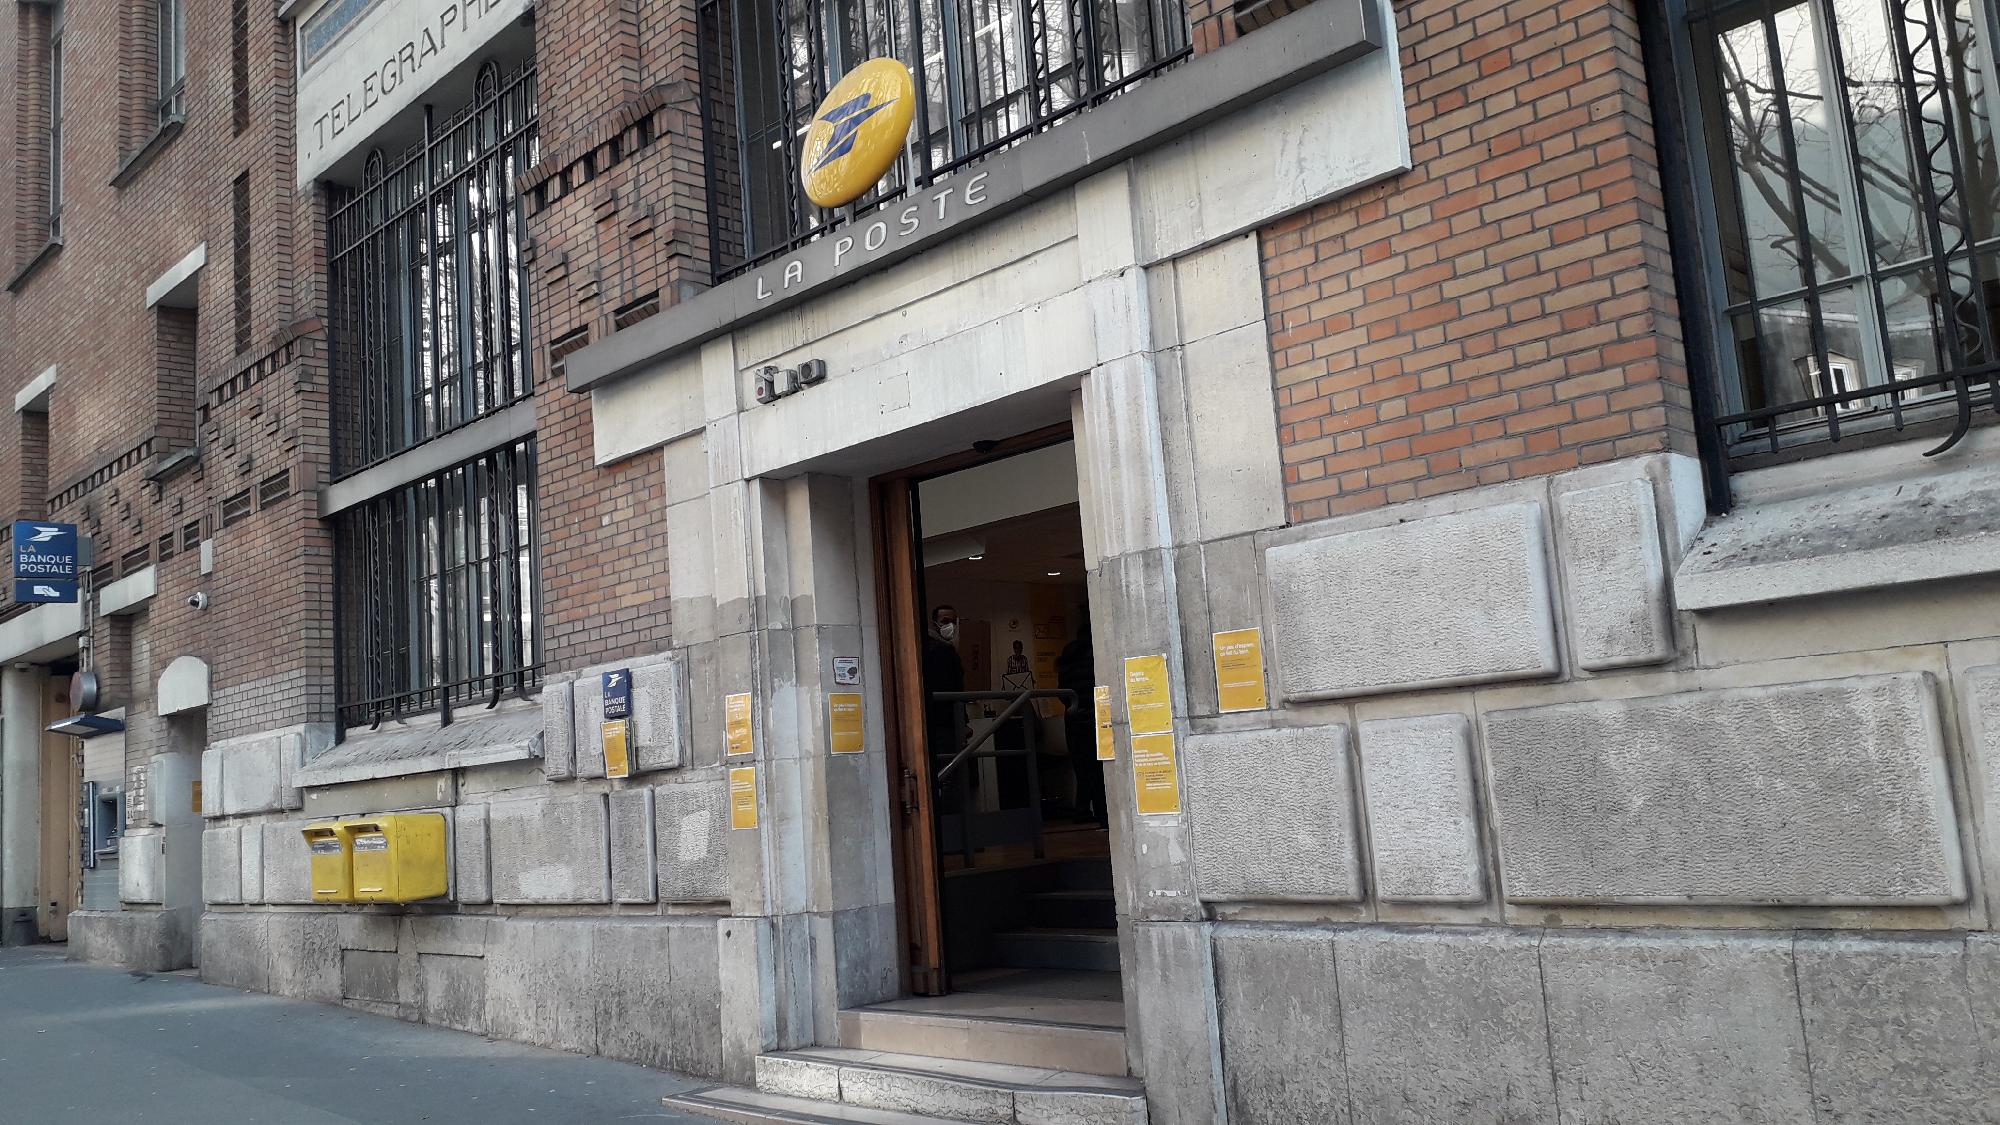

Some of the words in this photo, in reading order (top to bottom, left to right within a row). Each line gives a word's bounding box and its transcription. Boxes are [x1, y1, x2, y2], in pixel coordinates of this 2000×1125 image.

[756, 260, 803, 301] LA
[833, 171, 989, 267] POSTE
[20, 544, 36, 553] LA
[19, 554, 73, 564] BANQUE
[19, 564, 73, 574] POSTALE
[604, 696, 626, 706] BANQUE
[605, 704, 626, 714] POSTALE
